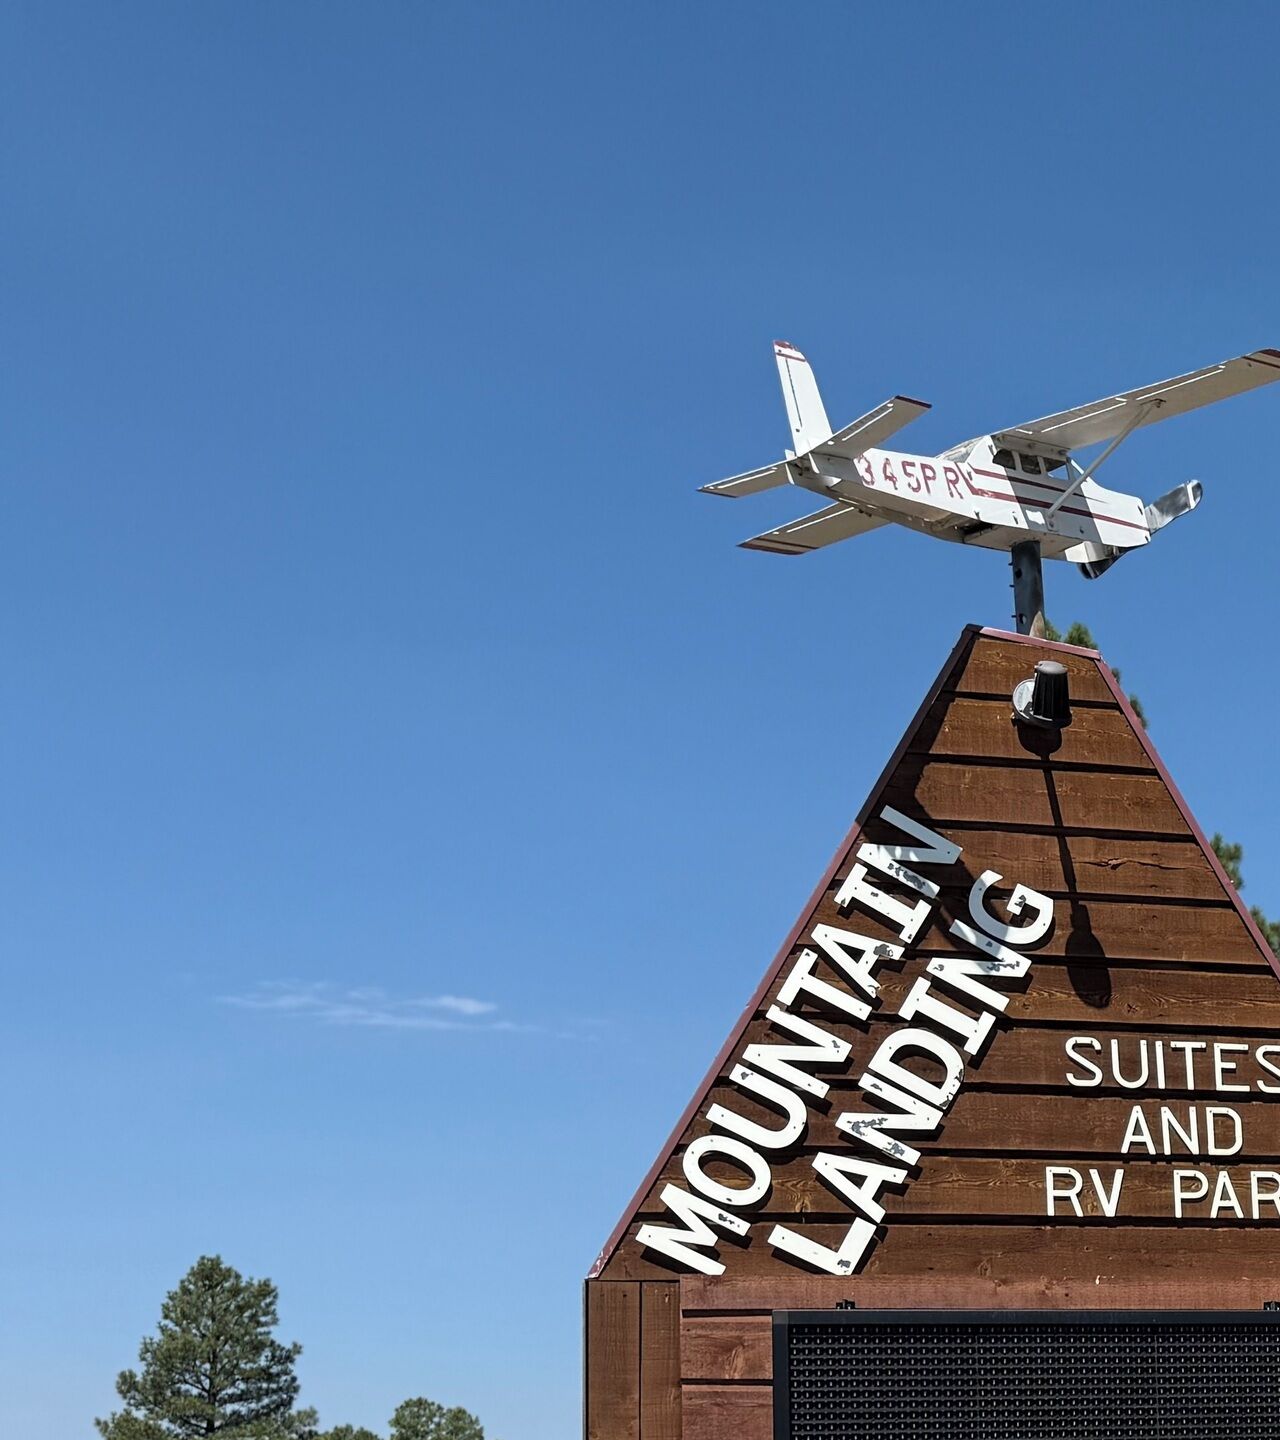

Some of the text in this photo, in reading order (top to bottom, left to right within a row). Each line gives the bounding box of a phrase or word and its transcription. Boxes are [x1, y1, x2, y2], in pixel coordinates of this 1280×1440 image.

[635, 805, 964, 1275] MOUNTAIN
[767, 869, 1055, 1275] LANDING
[1121, 1105, 1244, 1157] AND
[1046, 1166, 1125, 1218] RV
